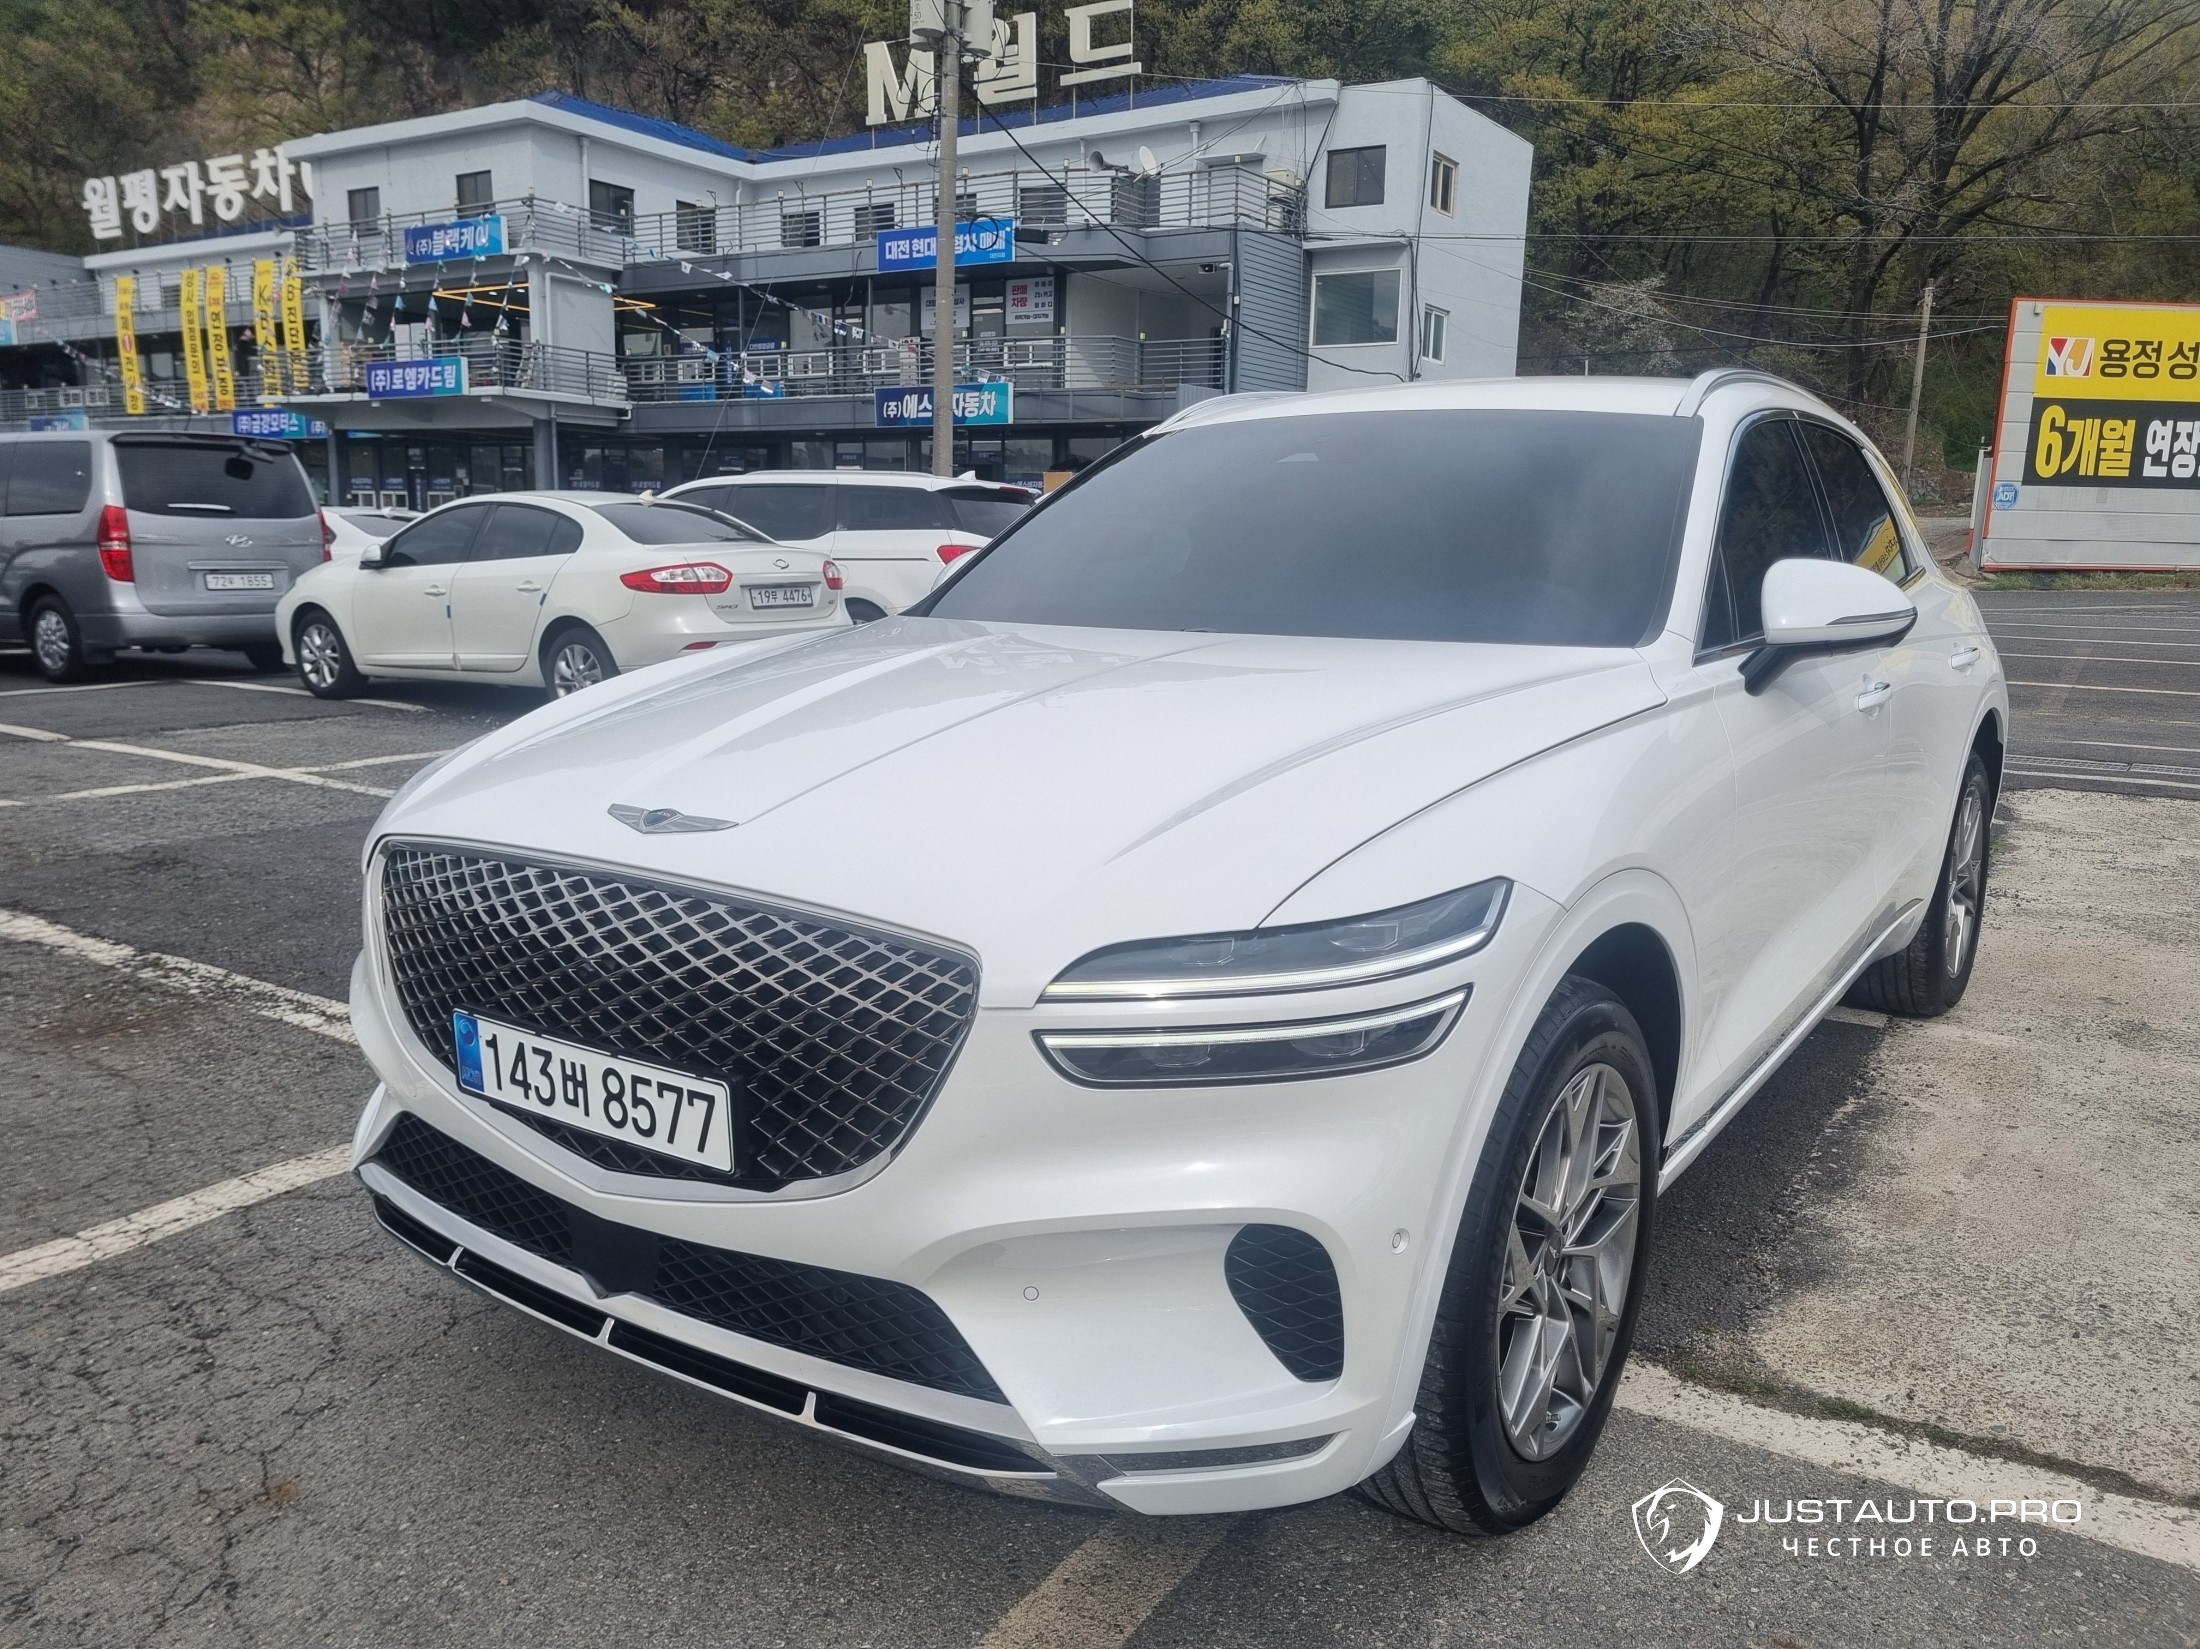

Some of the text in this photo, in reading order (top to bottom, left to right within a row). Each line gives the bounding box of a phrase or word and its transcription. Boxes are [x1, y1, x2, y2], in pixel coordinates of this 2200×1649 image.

[82, 146, 313, 240] 월평자동차
[885, 239, 910, 260] 대전
[911, 236, 937, 258] 현대
[1011, 284, 1028, 296] 판매
[1011, 297, 1028, 308] 차량
[2100, 338, 2163, 379] 용정
[371, 364, 456, 392] (주)로엠카드림
[883, 390, 997, 420] (주)에스자동차
[2035, 404, 2200, 479] 6개월 연장
[1997, 491, 2015, 502] ADT
[758, 589, 808, 604] 19무 4476
[485, 1033, 716, 1153] 143버 8577
